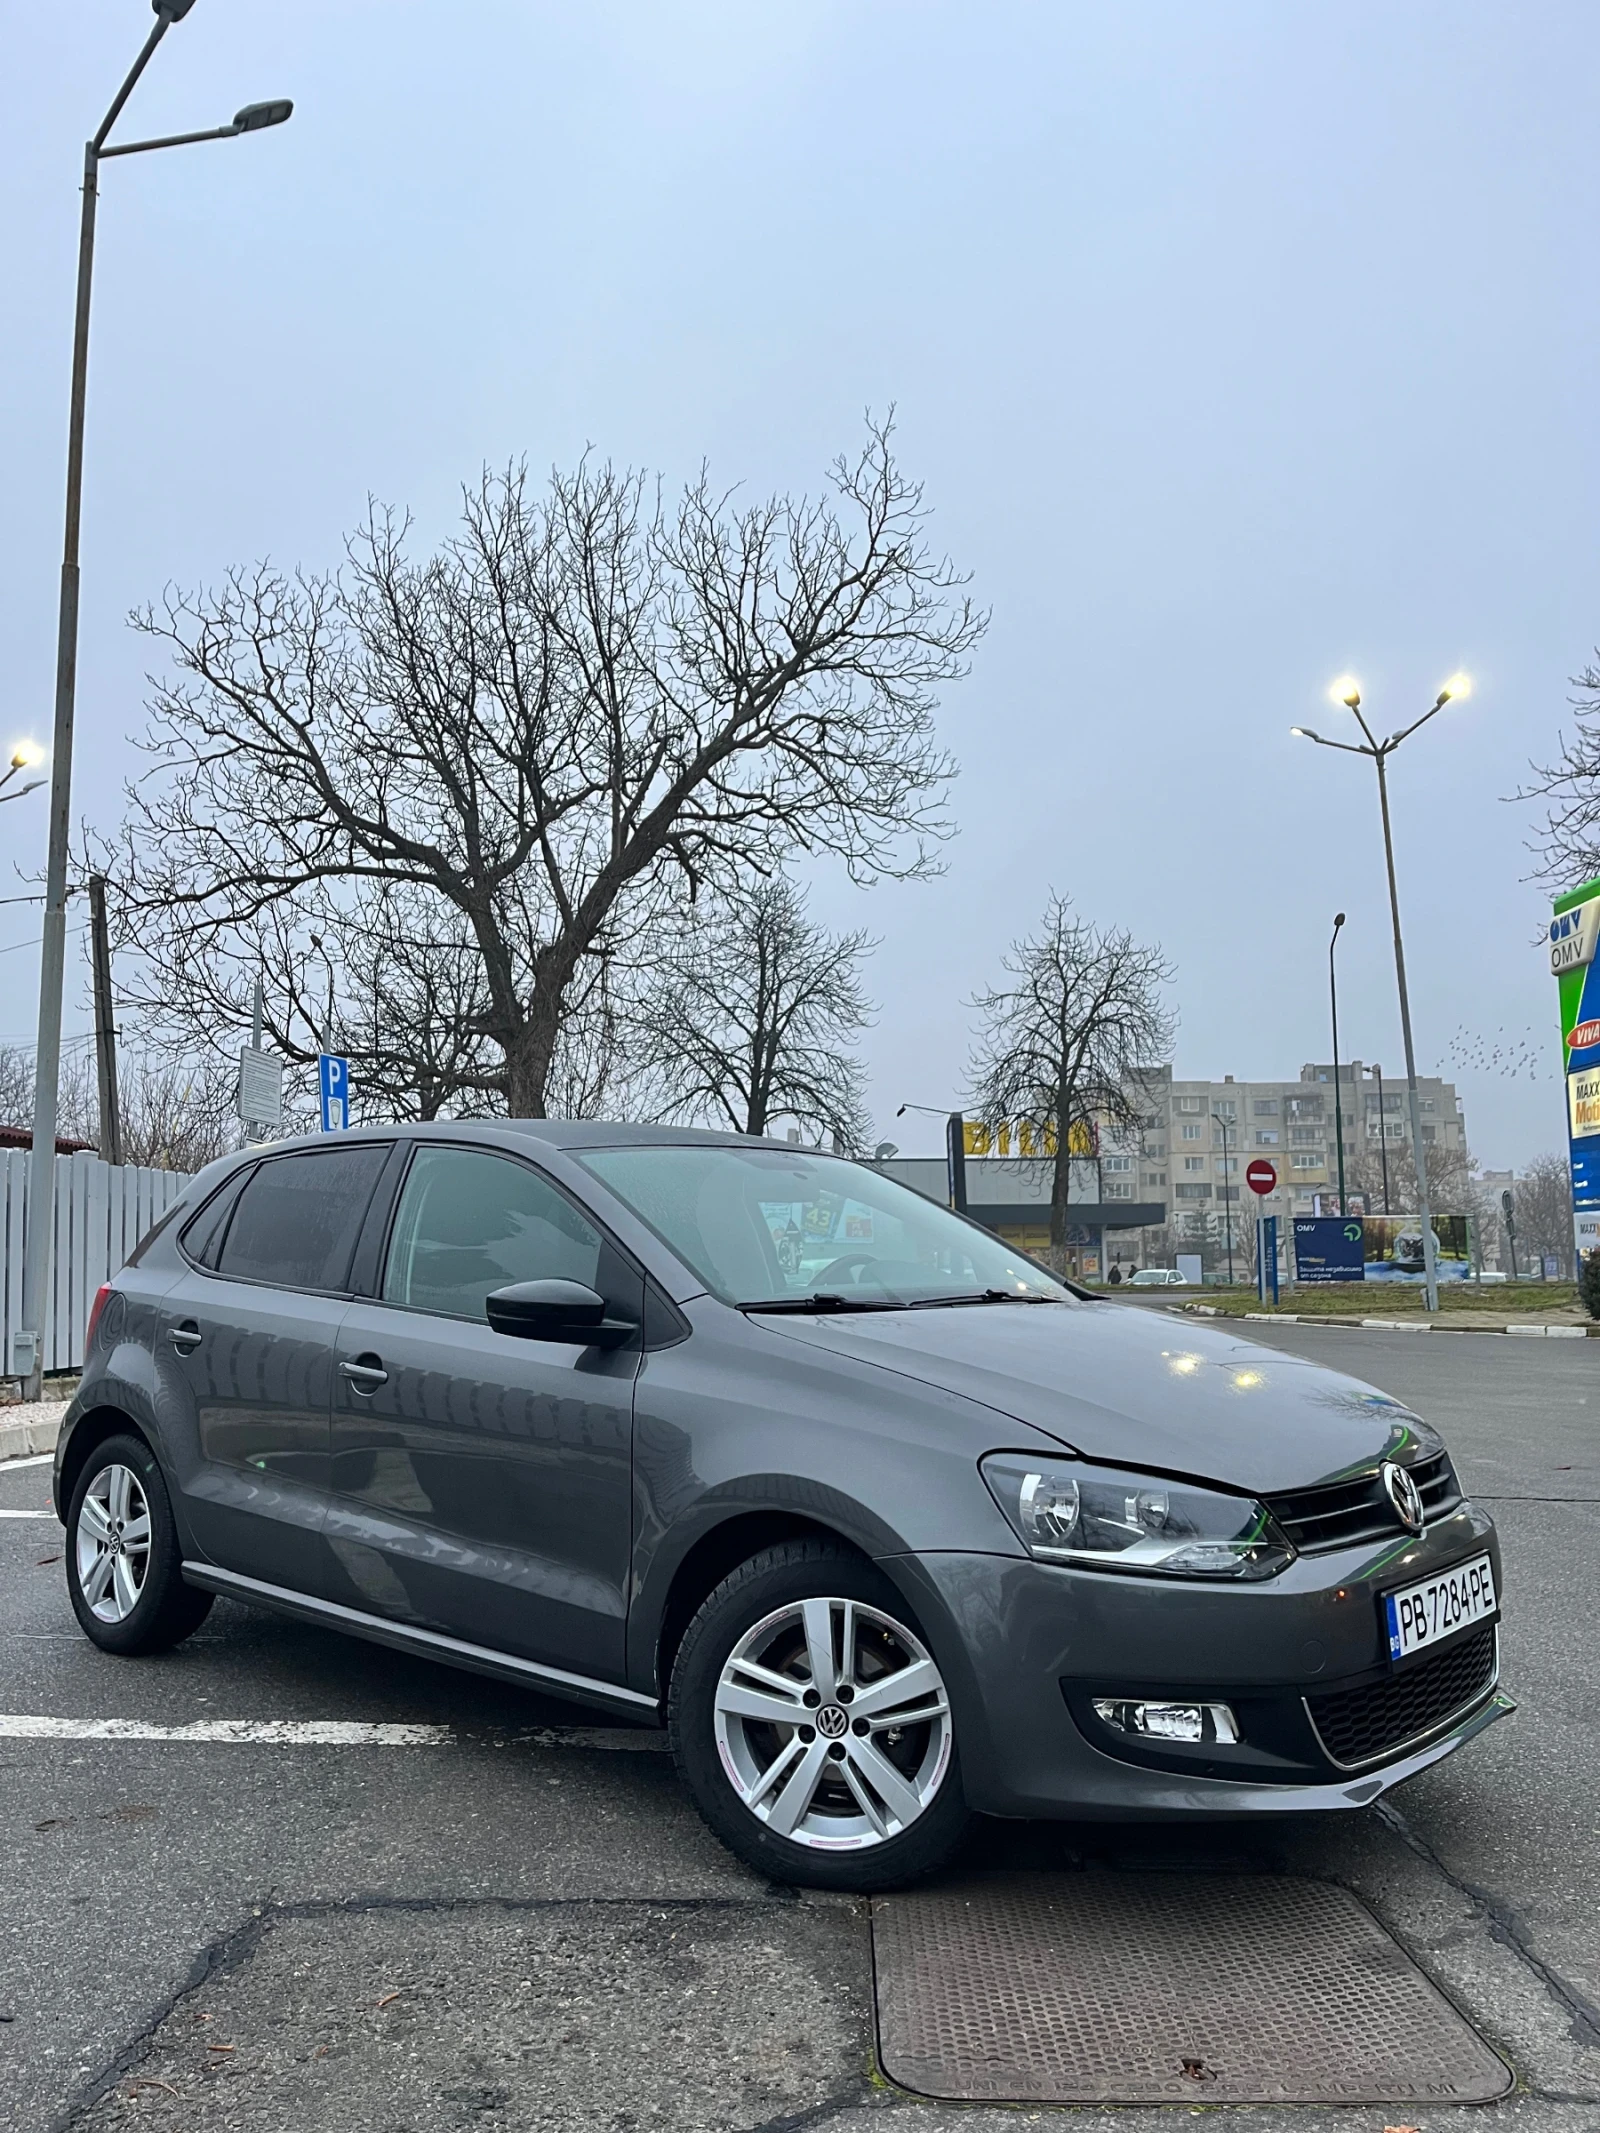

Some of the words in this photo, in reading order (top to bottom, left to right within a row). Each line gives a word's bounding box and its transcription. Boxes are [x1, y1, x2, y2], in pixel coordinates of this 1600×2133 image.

[1550, 908, 1581, 942] OMV
[1552, 937, 1583, 967] OMV
[1577, 1022, 1600, 1045] VIVA
[329, 1059, 341, 1095] P
[1576, 1081, 1600, 1100] MAXX
[1390, 1635, 1400, 1652] BG
